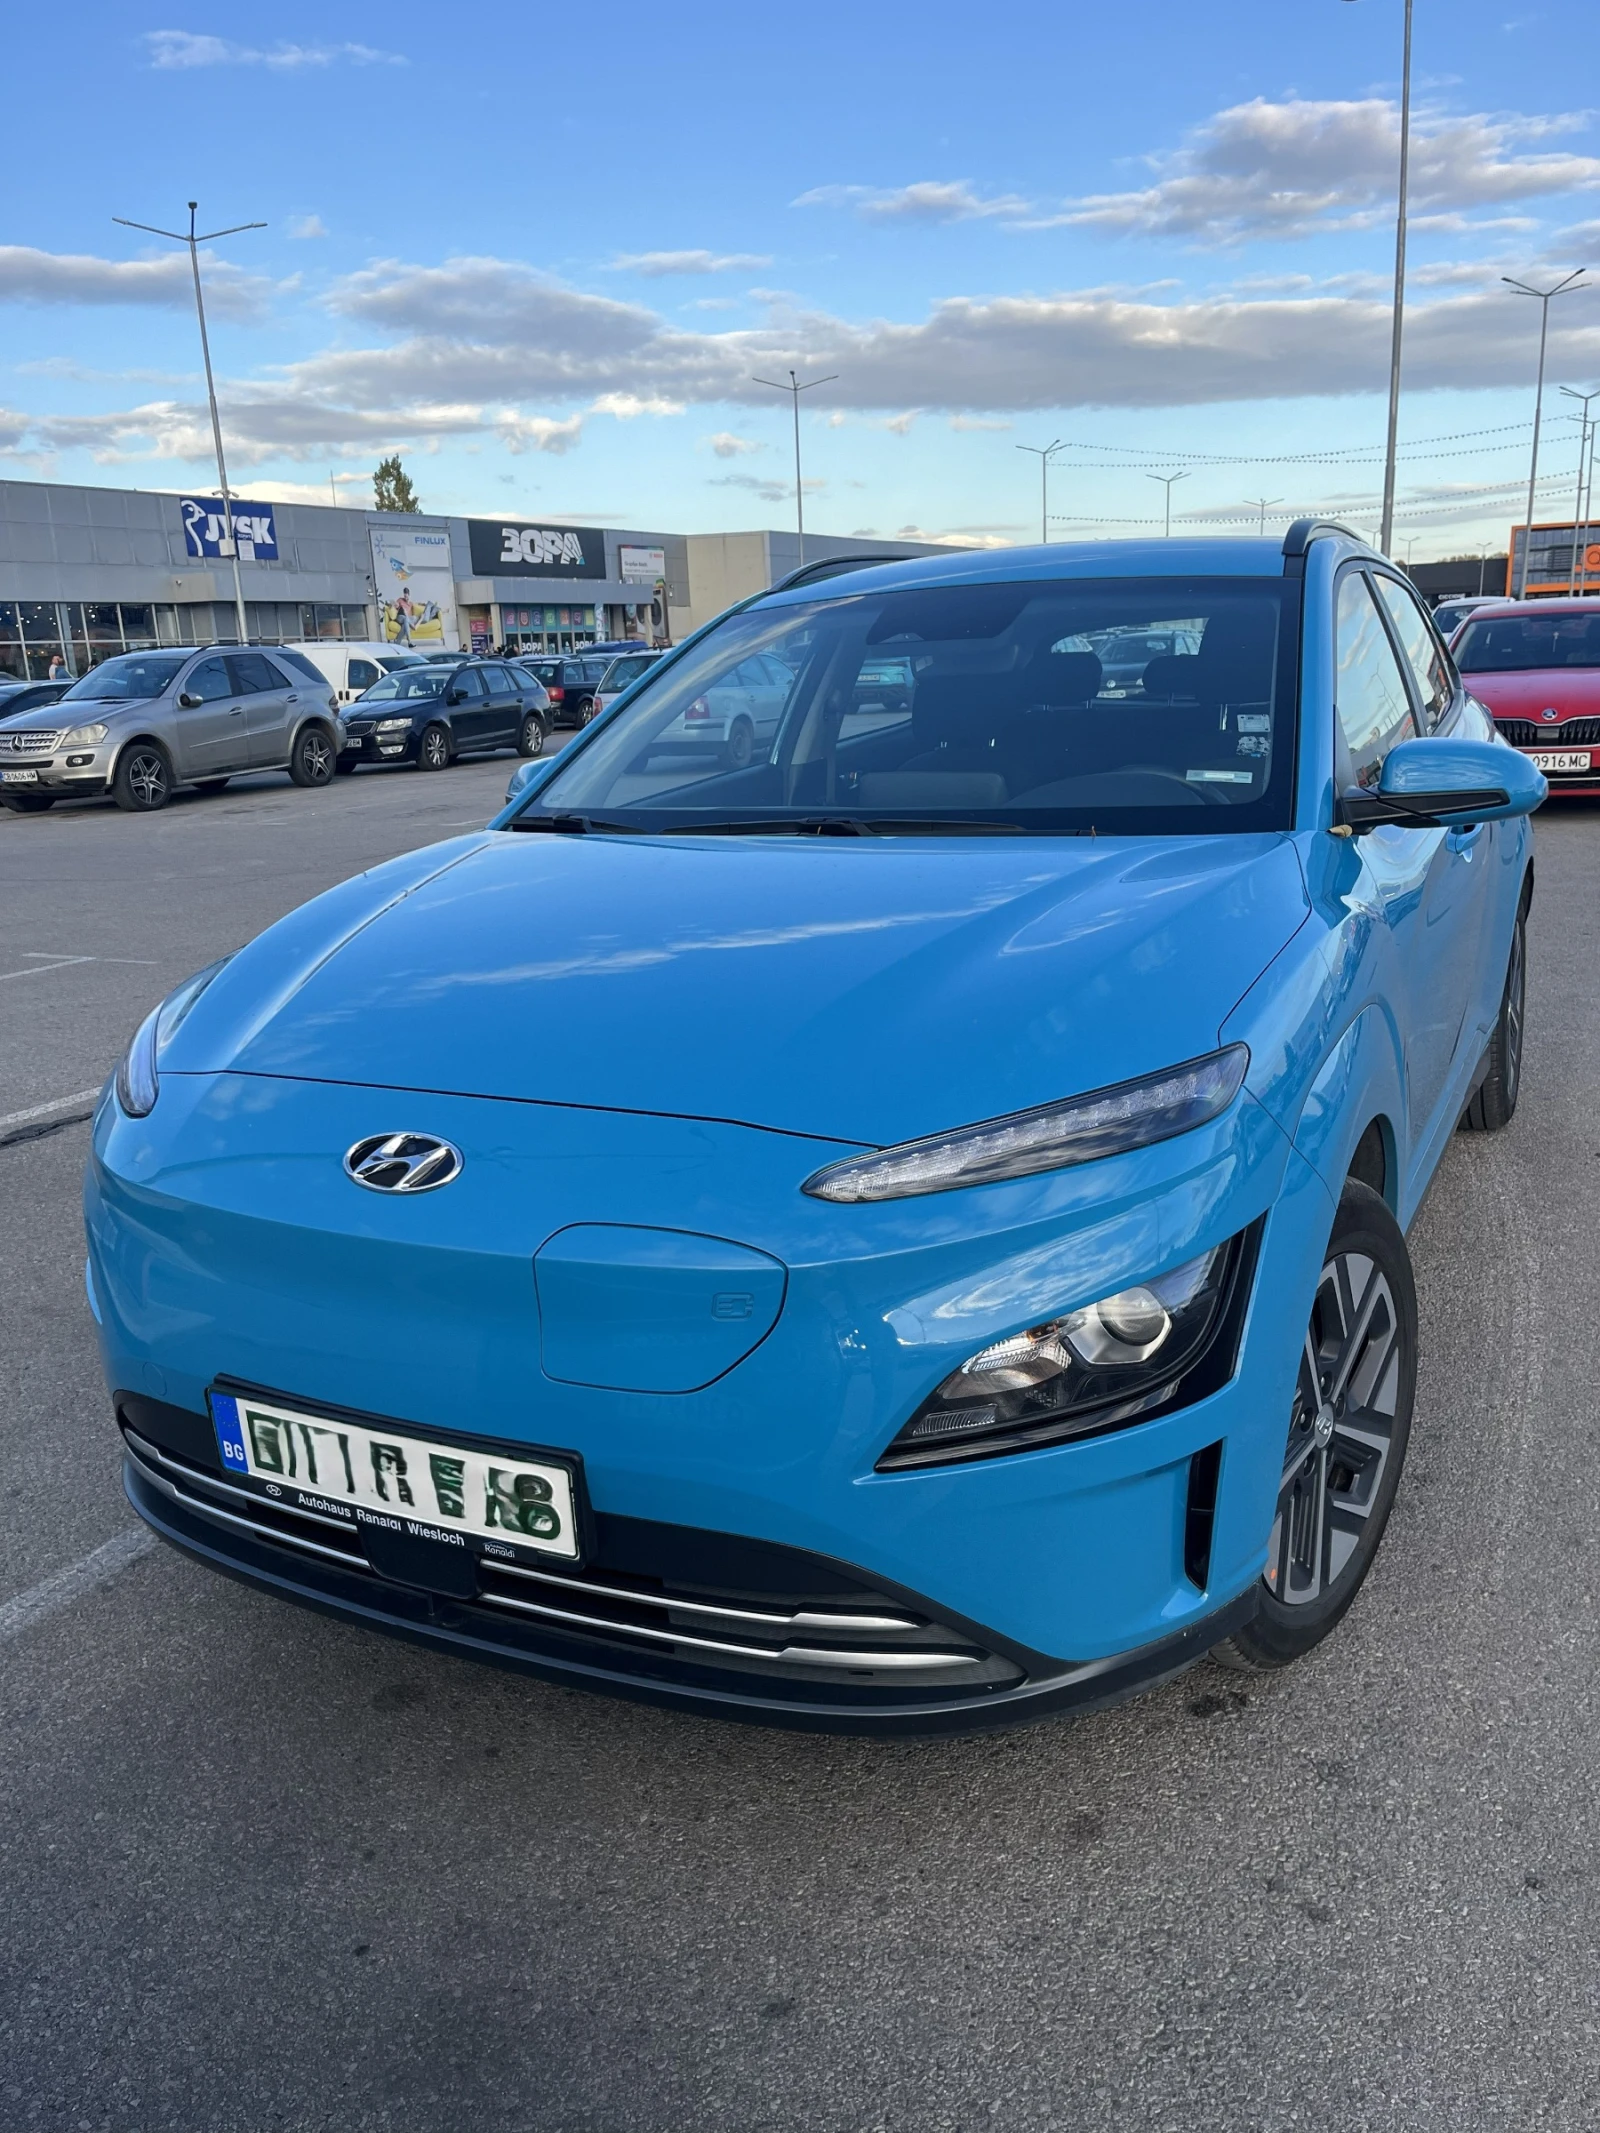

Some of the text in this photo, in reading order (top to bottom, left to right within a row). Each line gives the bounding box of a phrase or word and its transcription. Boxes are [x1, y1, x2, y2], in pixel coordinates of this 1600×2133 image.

[205, 513, 275, 544] JYSK
[414, 536, 446, 545] FINLUX
[500, 528, 585, 565] ЗОРА
[1533, 754, 1588, 768] 0916 MC
[223, 1440, 244, 1461] BG
[298, 1492, 352, 1518] Autohaus
[406, 1521, 465, 1546] Wiesloch
[484, 1543, 516, 1559] Ranaldi
